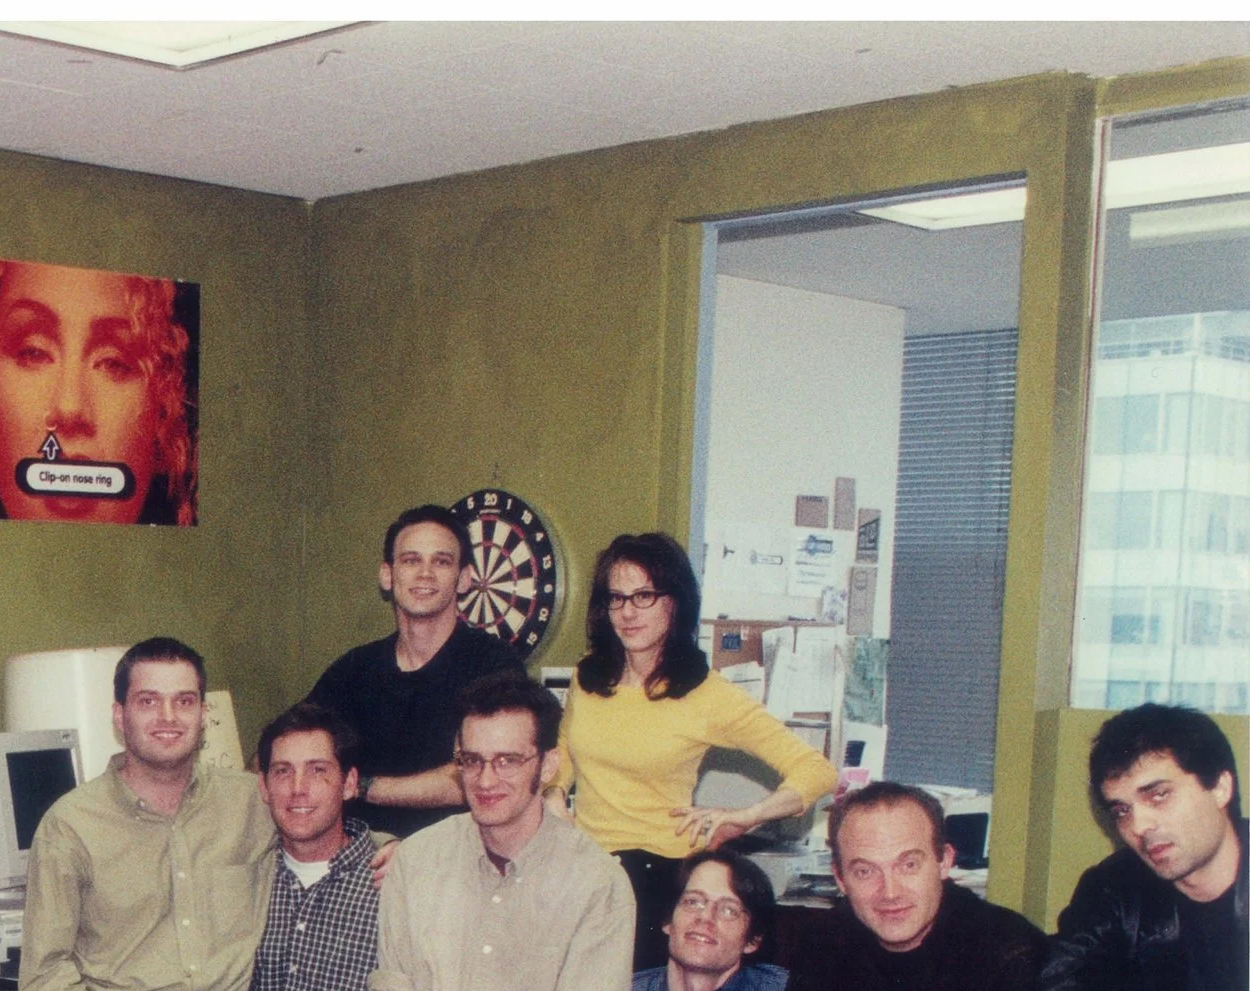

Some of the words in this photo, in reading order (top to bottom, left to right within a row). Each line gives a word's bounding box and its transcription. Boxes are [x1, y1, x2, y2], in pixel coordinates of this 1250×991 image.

[39, 471, 70, 484] Clip-on
[73, 475, 93, 484] nose
[96, 474, 112, 487] ring
[467, 497, 474, 509] 5
[484, 493, 498, 506] 20
[506, 499, 512, 510] 1
